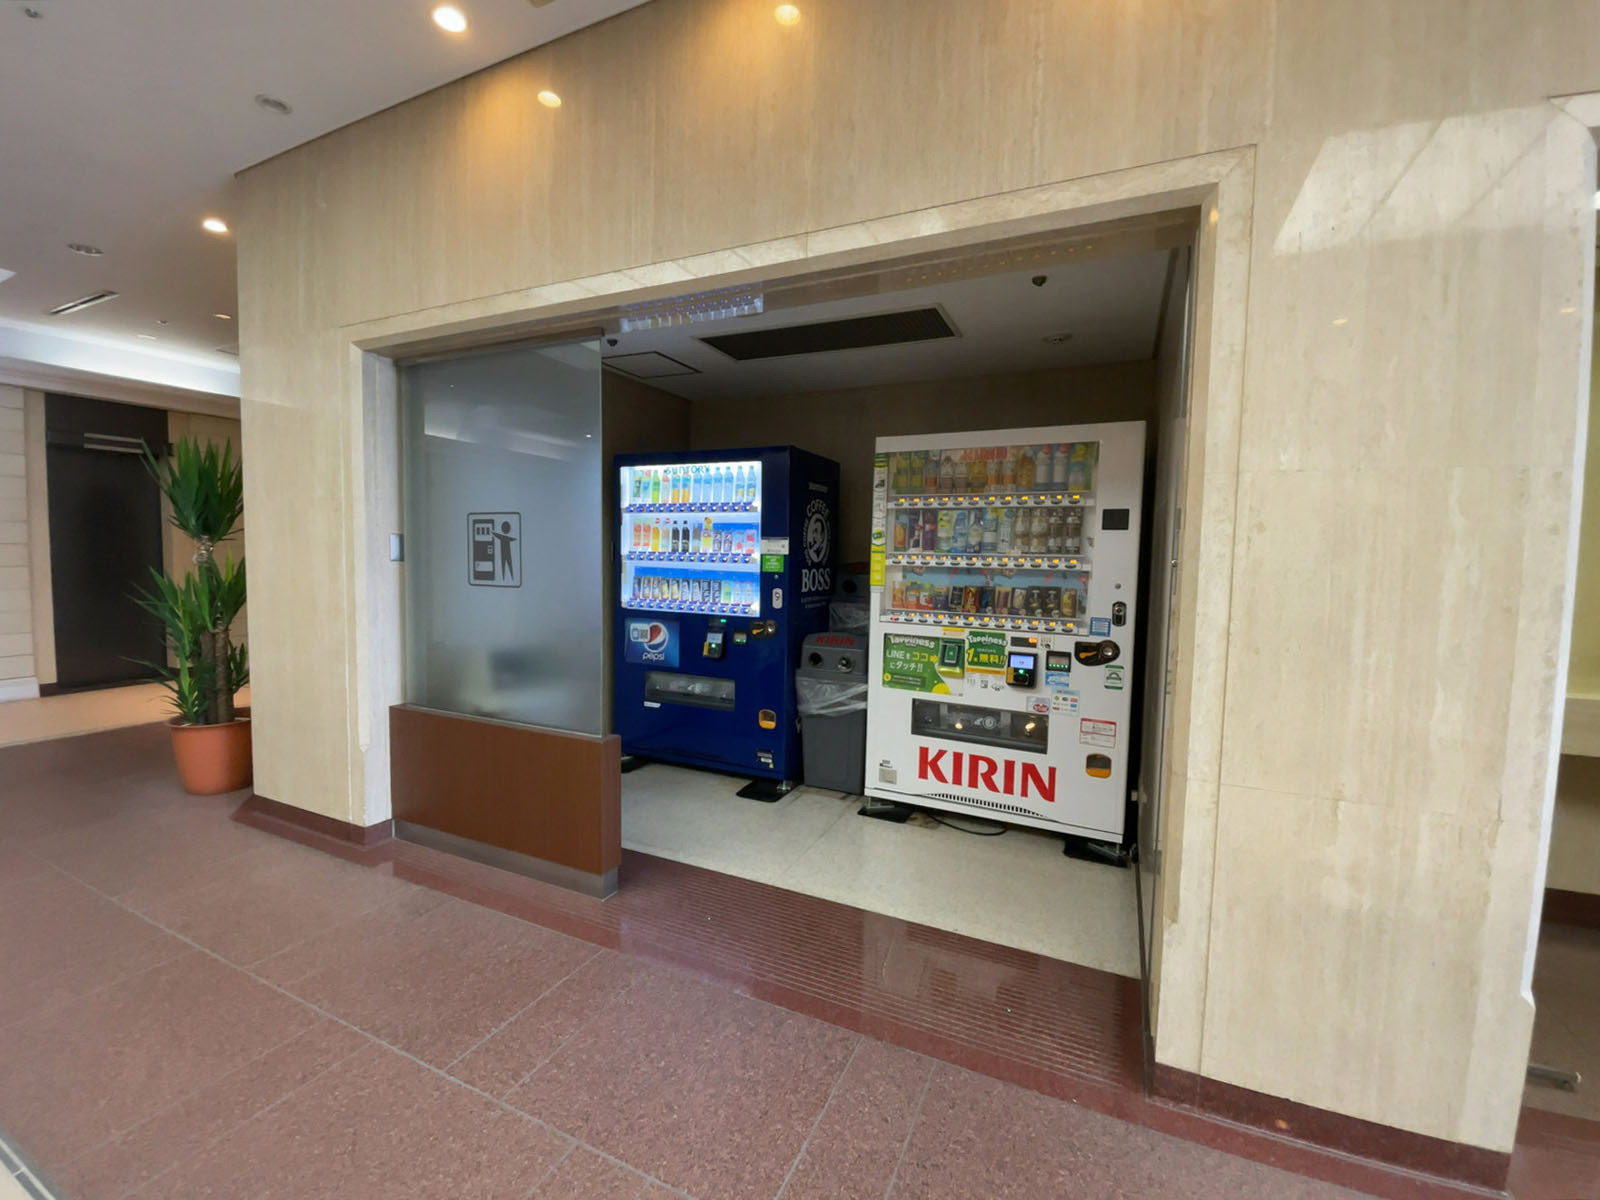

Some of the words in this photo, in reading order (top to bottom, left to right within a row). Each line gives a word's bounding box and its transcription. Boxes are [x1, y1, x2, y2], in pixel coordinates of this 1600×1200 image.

[801, 568, 830, 592] BOSS
[642, 652, 665, 661] pepsi
[918, 746, 1057, 802] KIRIN
